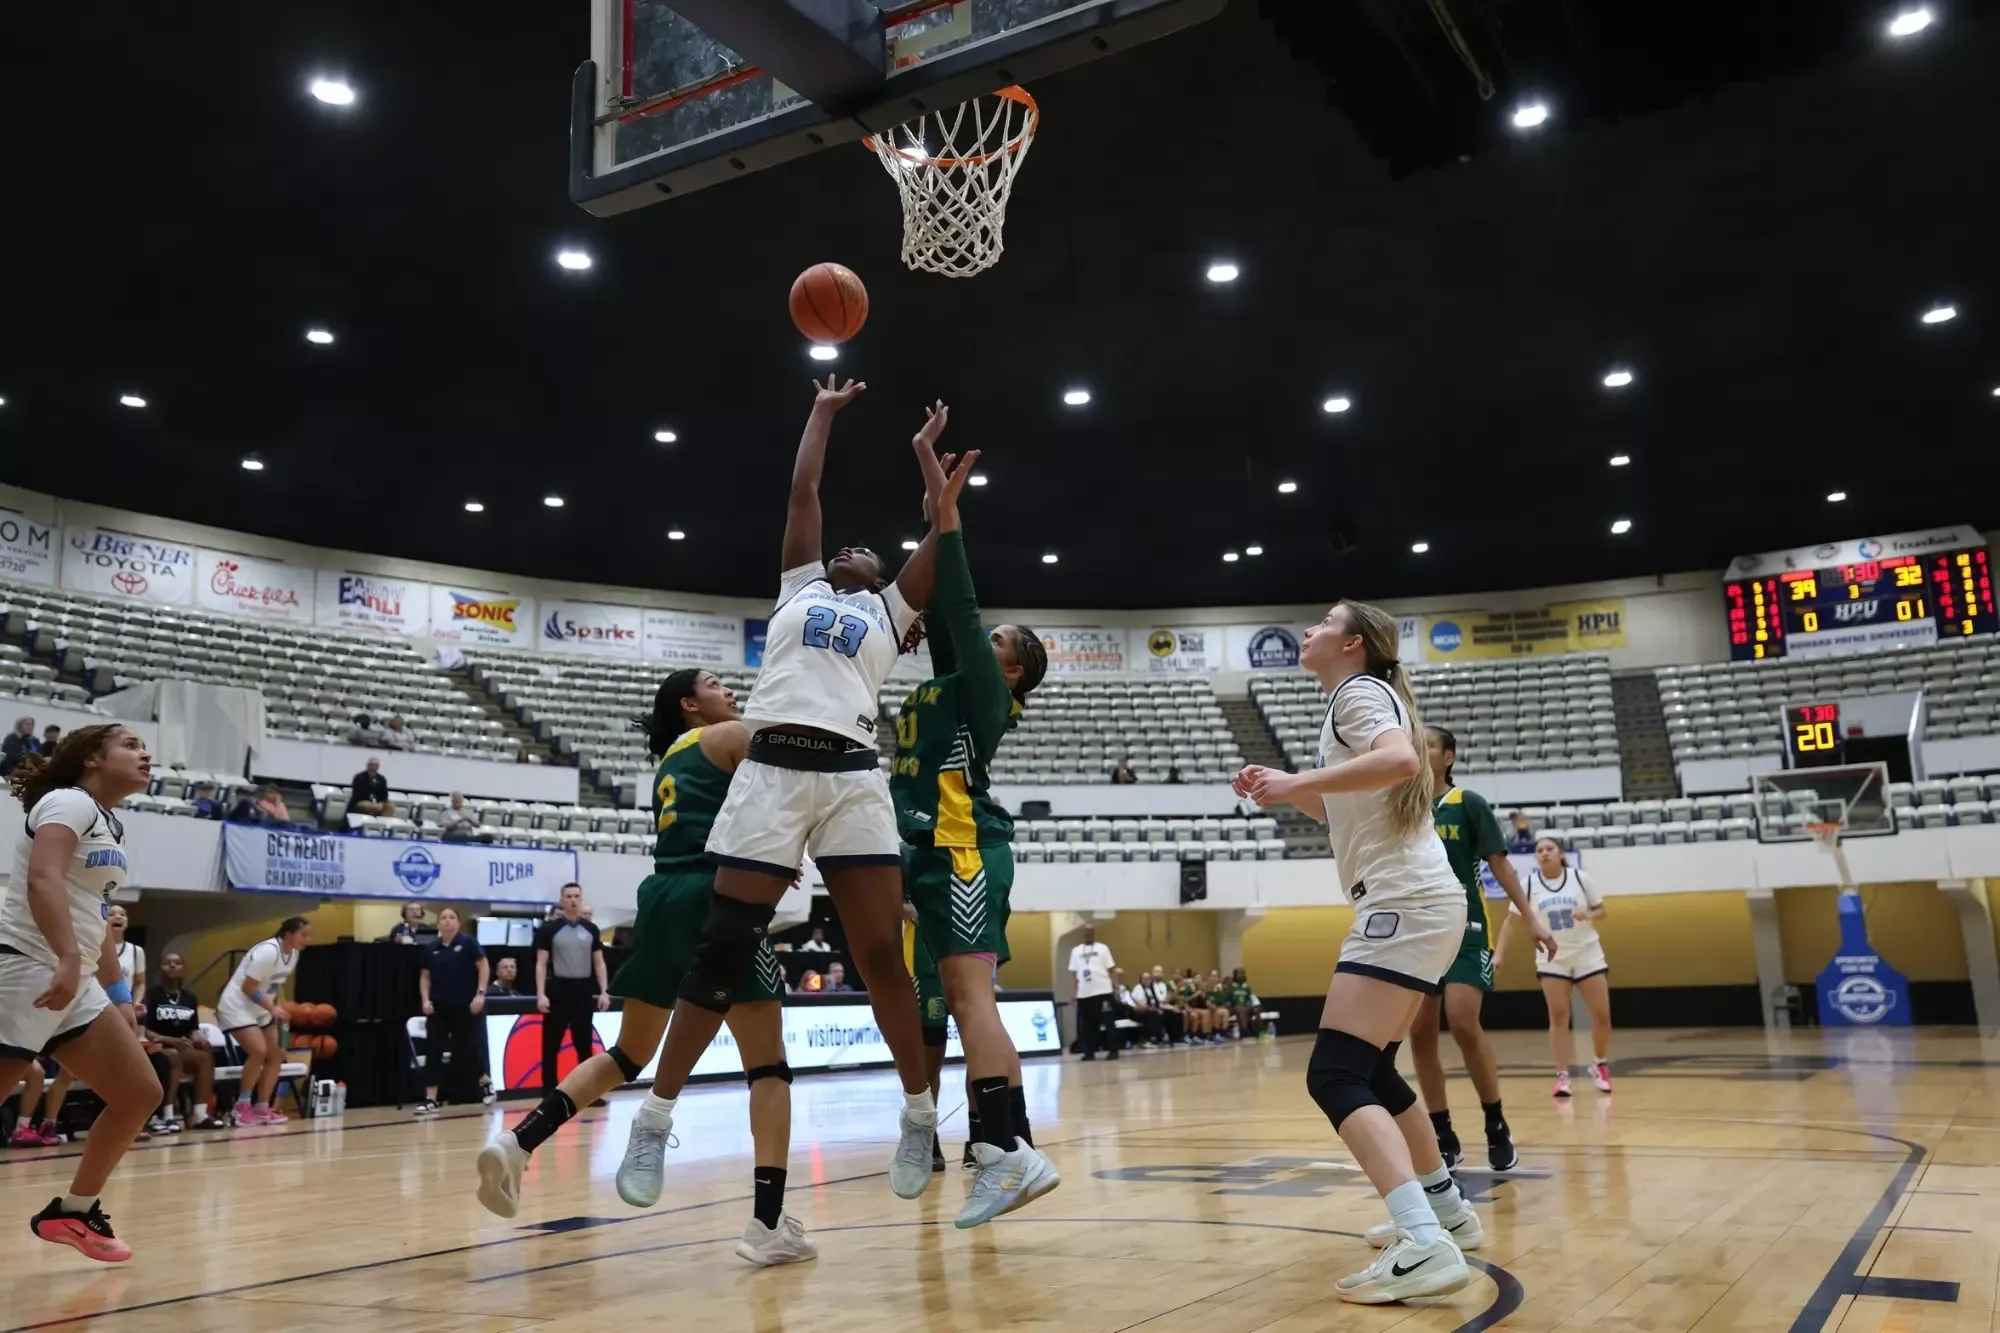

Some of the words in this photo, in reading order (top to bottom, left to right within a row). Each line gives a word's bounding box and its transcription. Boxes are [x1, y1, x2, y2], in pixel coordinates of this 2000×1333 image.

[1892, 533, 1960, 550] TexasBank
[81, 551, 175, 577] TOYOTA
[1894, 565, 1923, 587] 32
[1790, 579, 1817, 600] 39
[1848, 584, 1859, 599] 3
[455, 602, 515, 623] SONIC
[1835, 600, 1878, 620] HPU
[1577, 612, 1620, 630] HPU
[1803, 612, 1818, 632] 0
[564, 620, 636, 643] Sparks
[802, 605, 869, 658] 23
[1060, 632, 1100, 641] LOCK
[1870, 626, 1934, 641] UNIVERSITY
[1060, 642, 1106, 652] LEAVE
[1108, 642, 1121, 652] IT
[1069, 661, 1122, 671] STORAGE
[768, 734, 836, 750] GRADUAL
[1796, 722, 1835, 751] 20
[657, 773, 677, 832] 2
[267, 834, 288, 858] GET
[294, 838, 336, 861] READY
[266, 869, 345, 890] CHAMPIONSHIP
